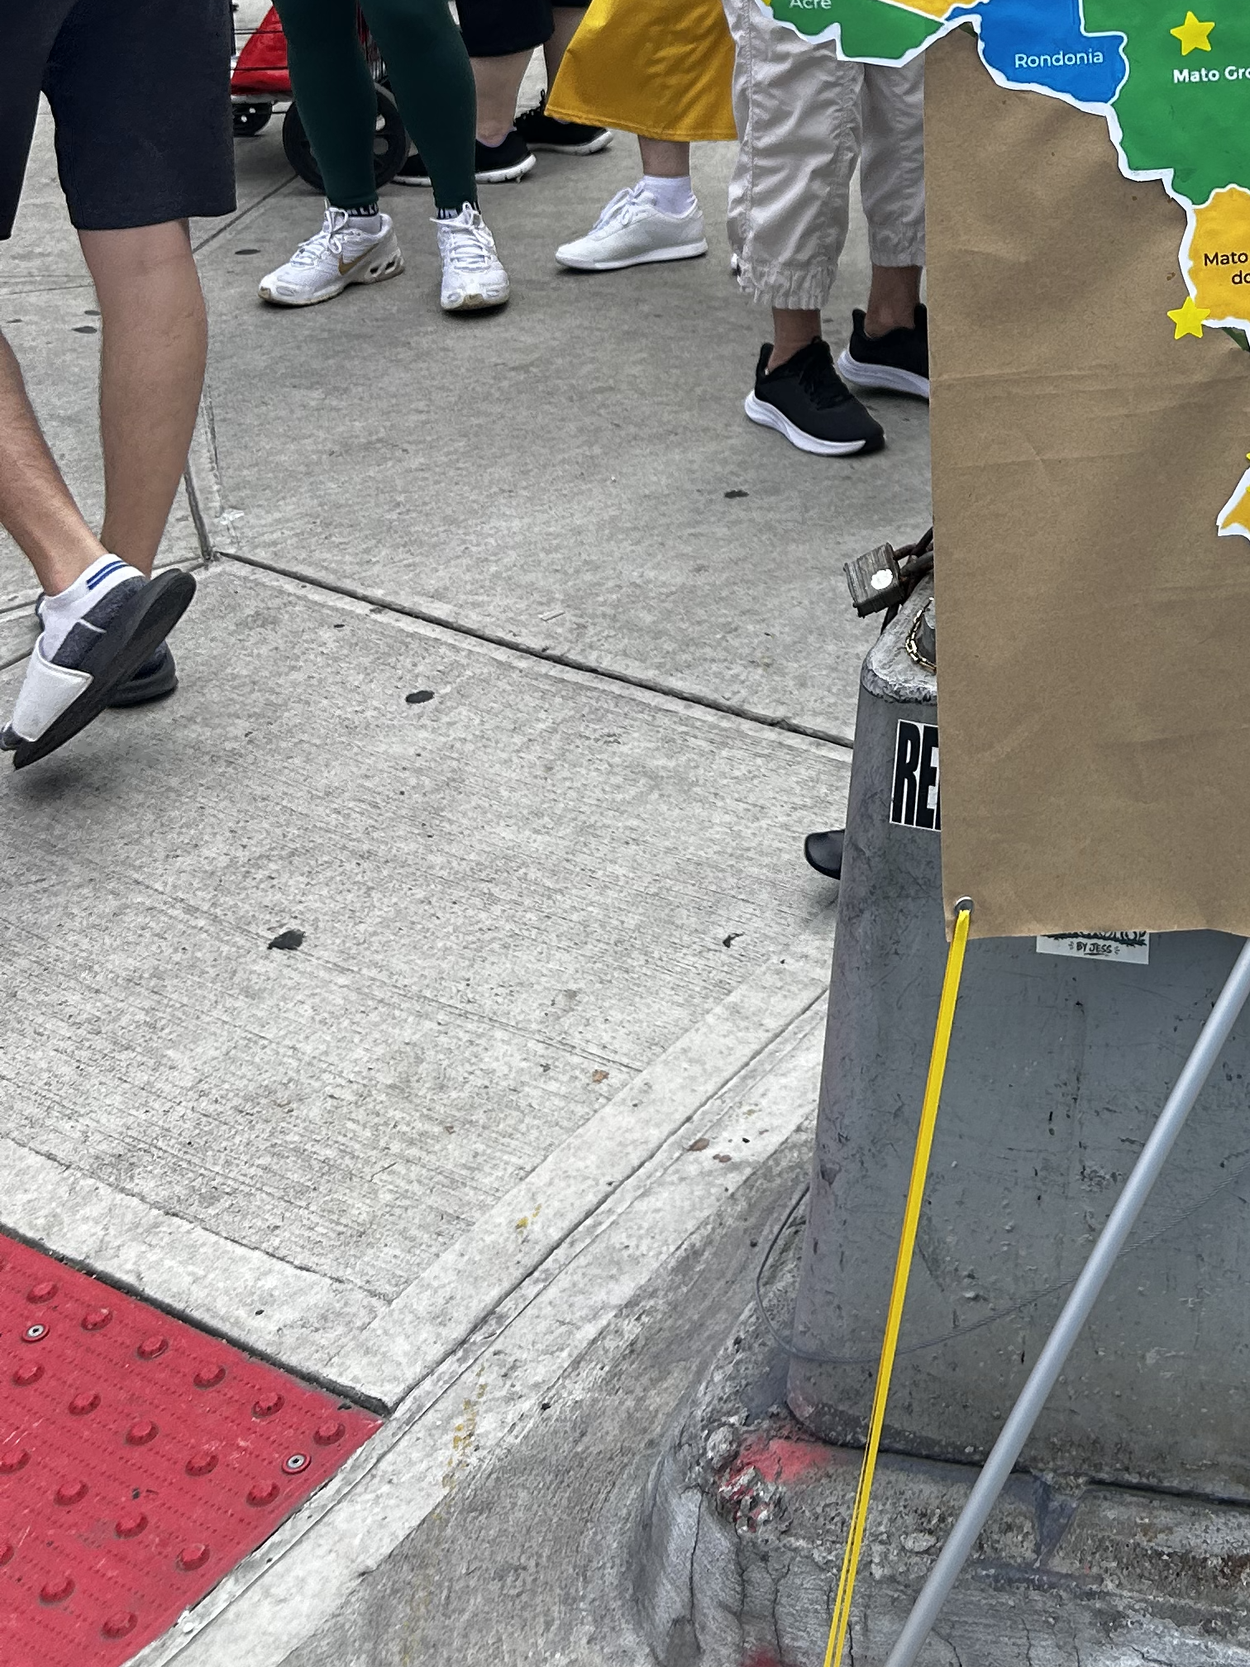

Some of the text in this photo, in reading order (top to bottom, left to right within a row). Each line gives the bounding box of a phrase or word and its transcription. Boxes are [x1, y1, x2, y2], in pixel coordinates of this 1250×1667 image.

[1014, 48, 1104, 69] Rondonia
[1173, 68, 1221, 84] Mato
[1203, 251, 1249, 267] Mato
[891, 720, 942, 831] RE
[1089, 942, 1113, 954] JESS
